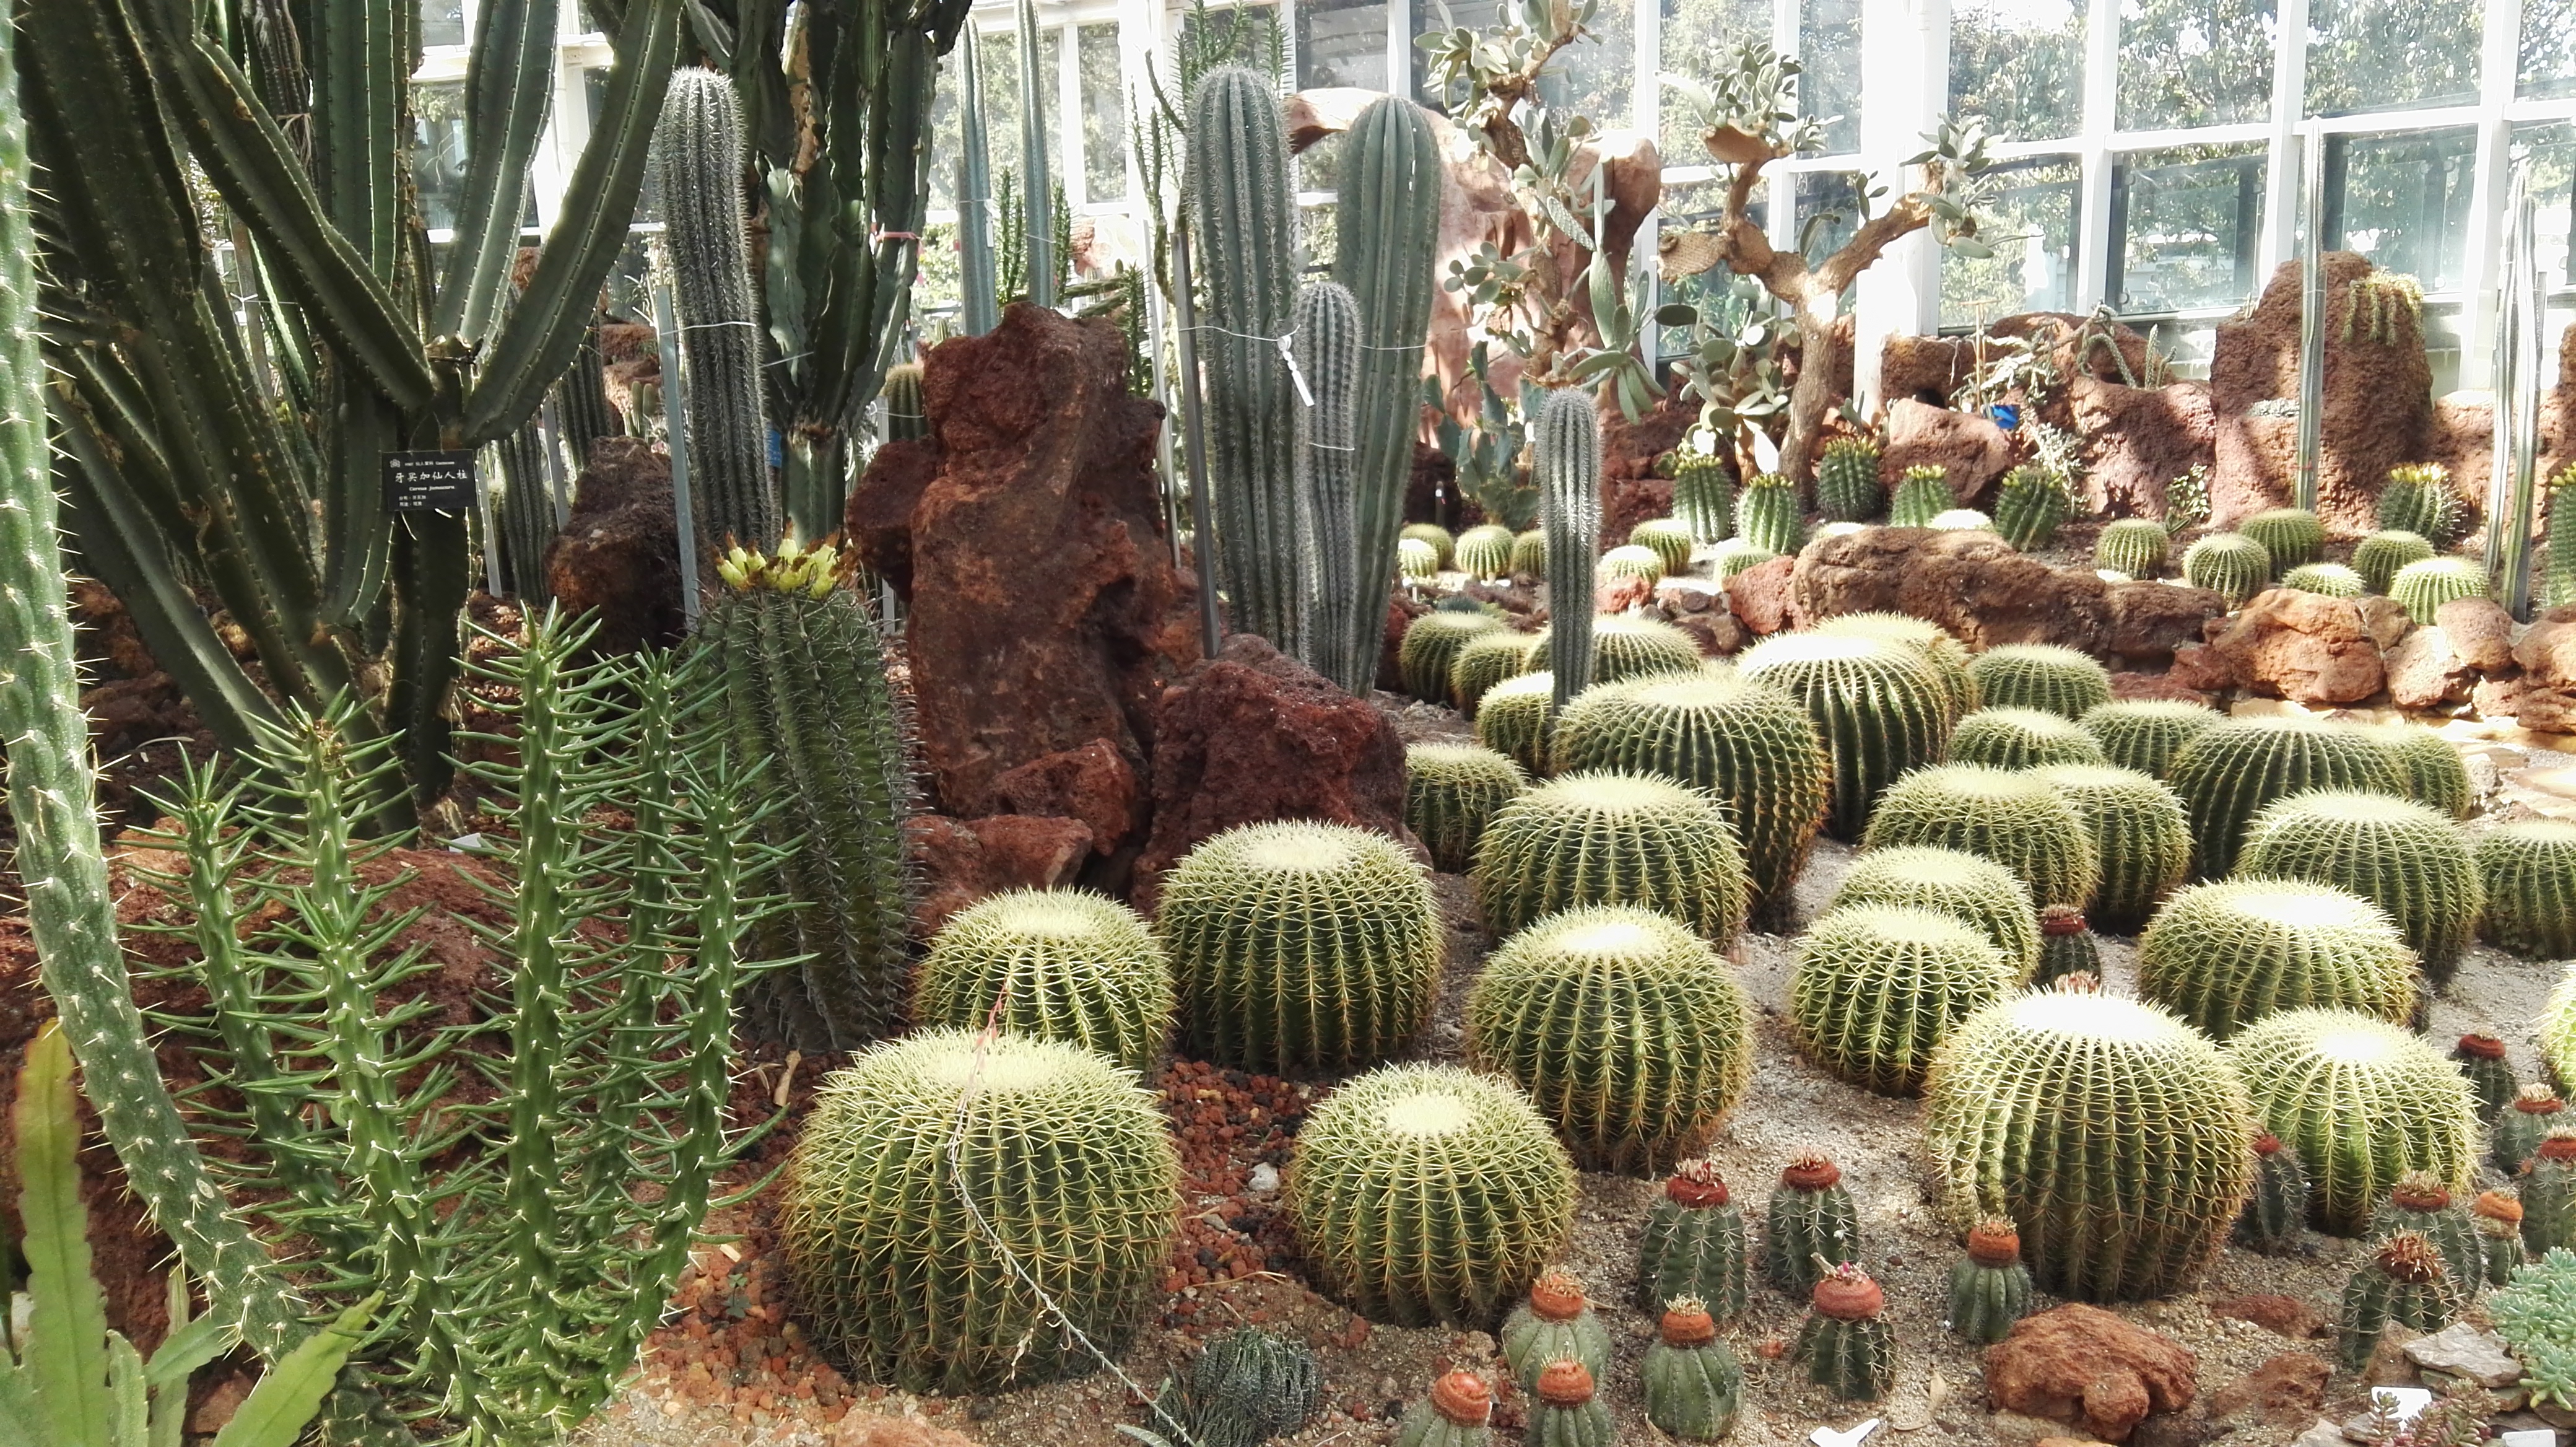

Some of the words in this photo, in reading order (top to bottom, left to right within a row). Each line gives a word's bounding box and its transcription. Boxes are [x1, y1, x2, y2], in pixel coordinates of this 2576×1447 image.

[395, 469, 468, 483] 牙买加仙人柱
